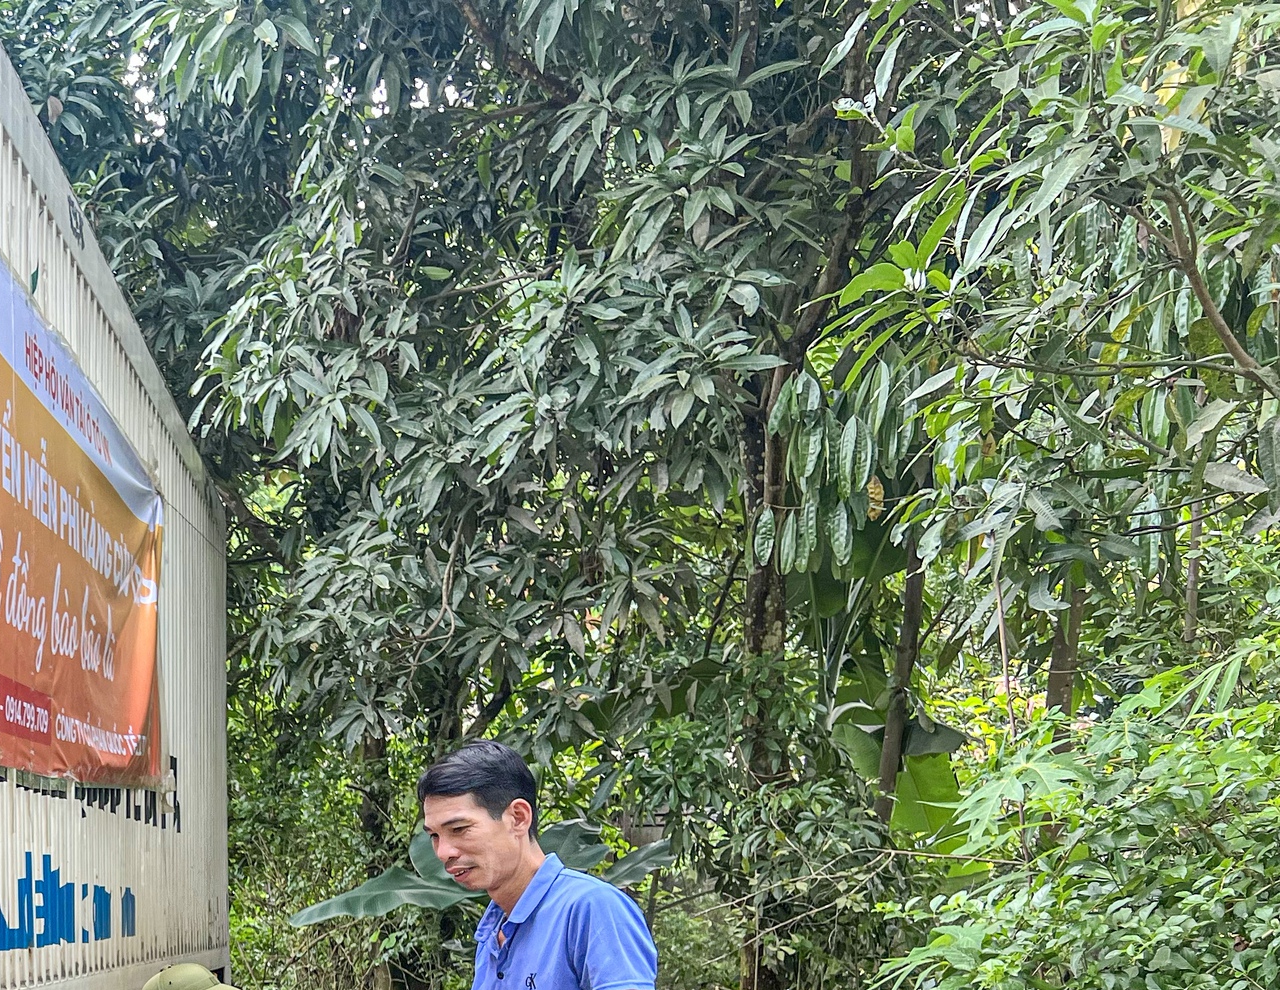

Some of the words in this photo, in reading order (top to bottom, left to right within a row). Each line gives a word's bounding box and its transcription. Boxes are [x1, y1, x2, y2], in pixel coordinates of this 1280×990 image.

[24, 331, 44, 390] HIỆP
[44, 356, 59, 410] HỘI
[59, 374, 75, 427] VẬN
[23, 437, 59, 535] MIỄN
[59, 485, 80, 554] PHÍ
[80, 499, 113, 580] HÀNG
[4, 530, 49, 673] đồng
[50, 562, 79, 659] bào
[5, 694, 49, 734] 0914.799.709
[55, 707, 77, 744] CÔNG
